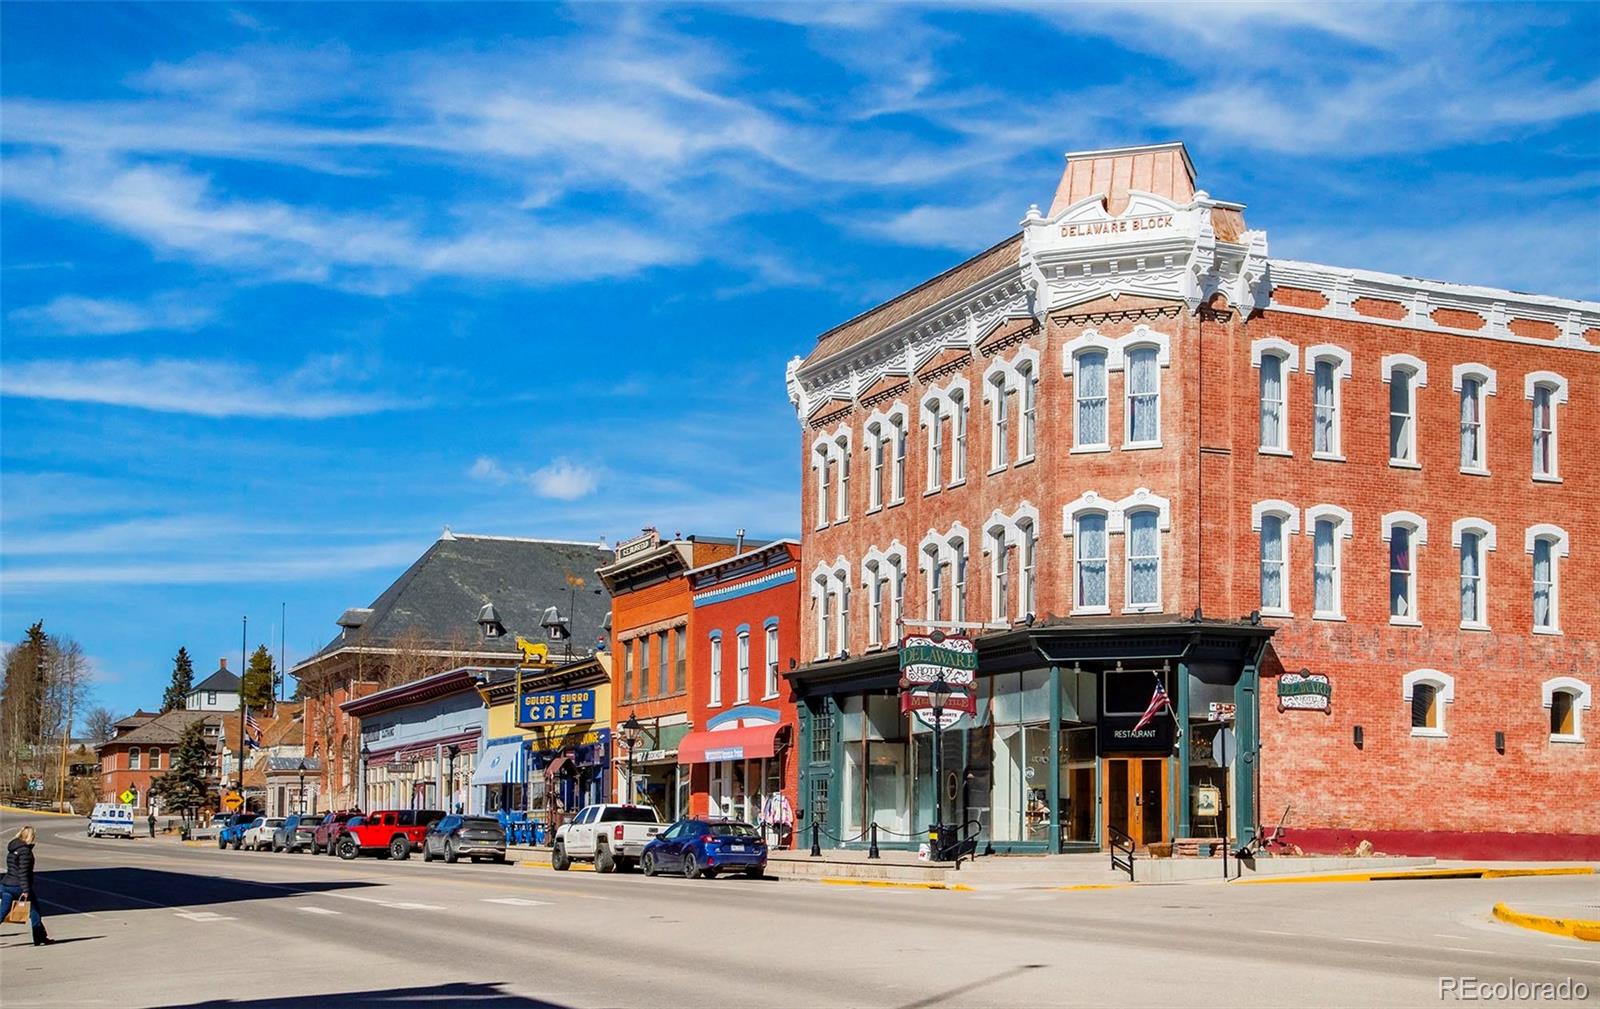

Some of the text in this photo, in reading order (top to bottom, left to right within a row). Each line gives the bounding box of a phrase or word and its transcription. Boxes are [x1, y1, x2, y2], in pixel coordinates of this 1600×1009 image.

[1060, 216, 1174, 238] DELAWARE BLOCK
[903, 646, 976, 668] DELAWARE
[916, 666, 941, 676] HOTE
[525, 693, 588, 706] GOLDEN BURRO
[529, 703, 582, 720] CAFE
[1114, 729, 1156, 739] RESTAURANT
